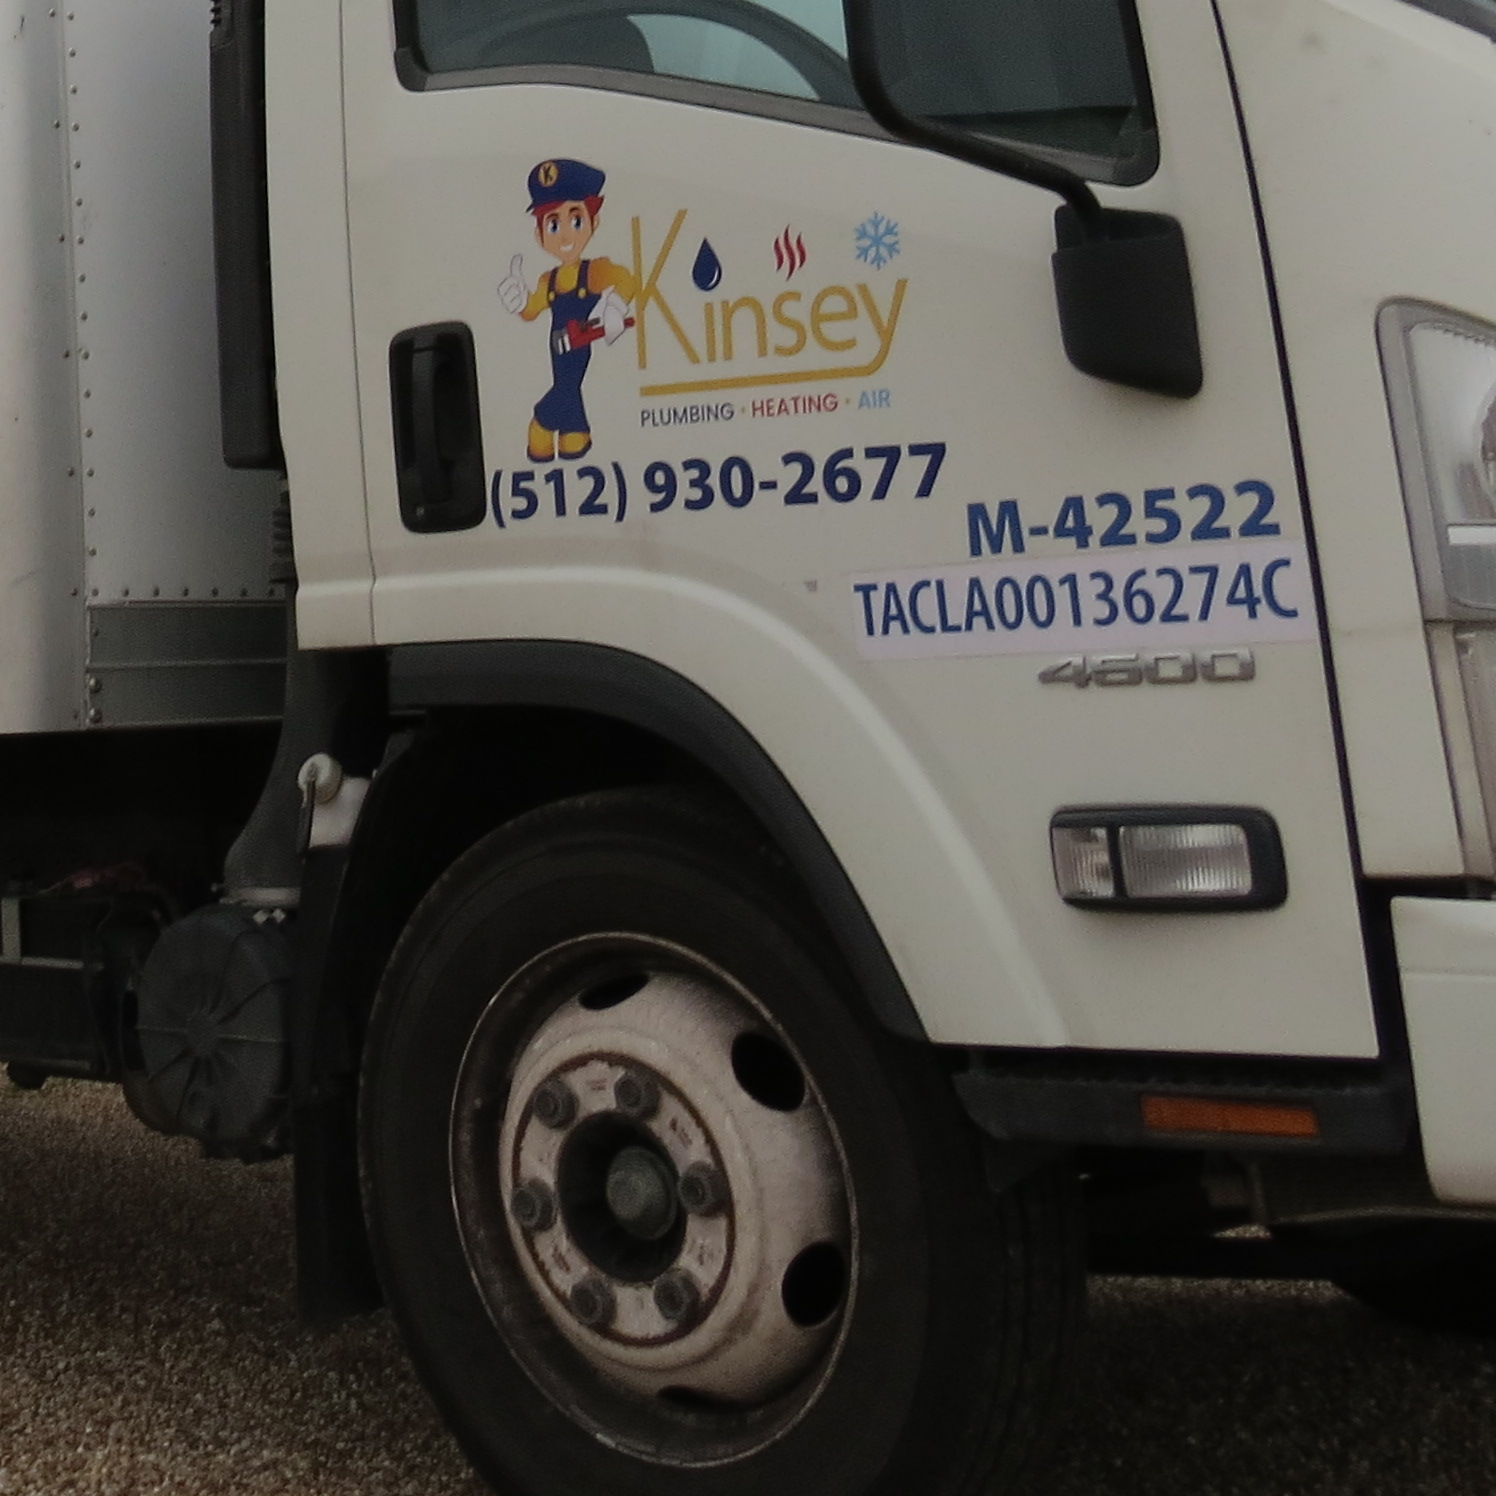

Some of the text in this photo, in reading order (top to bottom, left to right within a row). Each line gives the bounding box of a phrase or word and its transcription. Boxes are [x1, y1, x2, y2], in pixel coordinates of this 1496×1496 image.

[631, 207, 908, 371] Kinsey
[640, 388, 891, 428] PLUMBING HEATING AIR
[491, 442, 947, 529] (512) 930-2677
[966, 480, 1282, 558] M-42522
[854, 558, 1299, 637] TACLA00136274C
